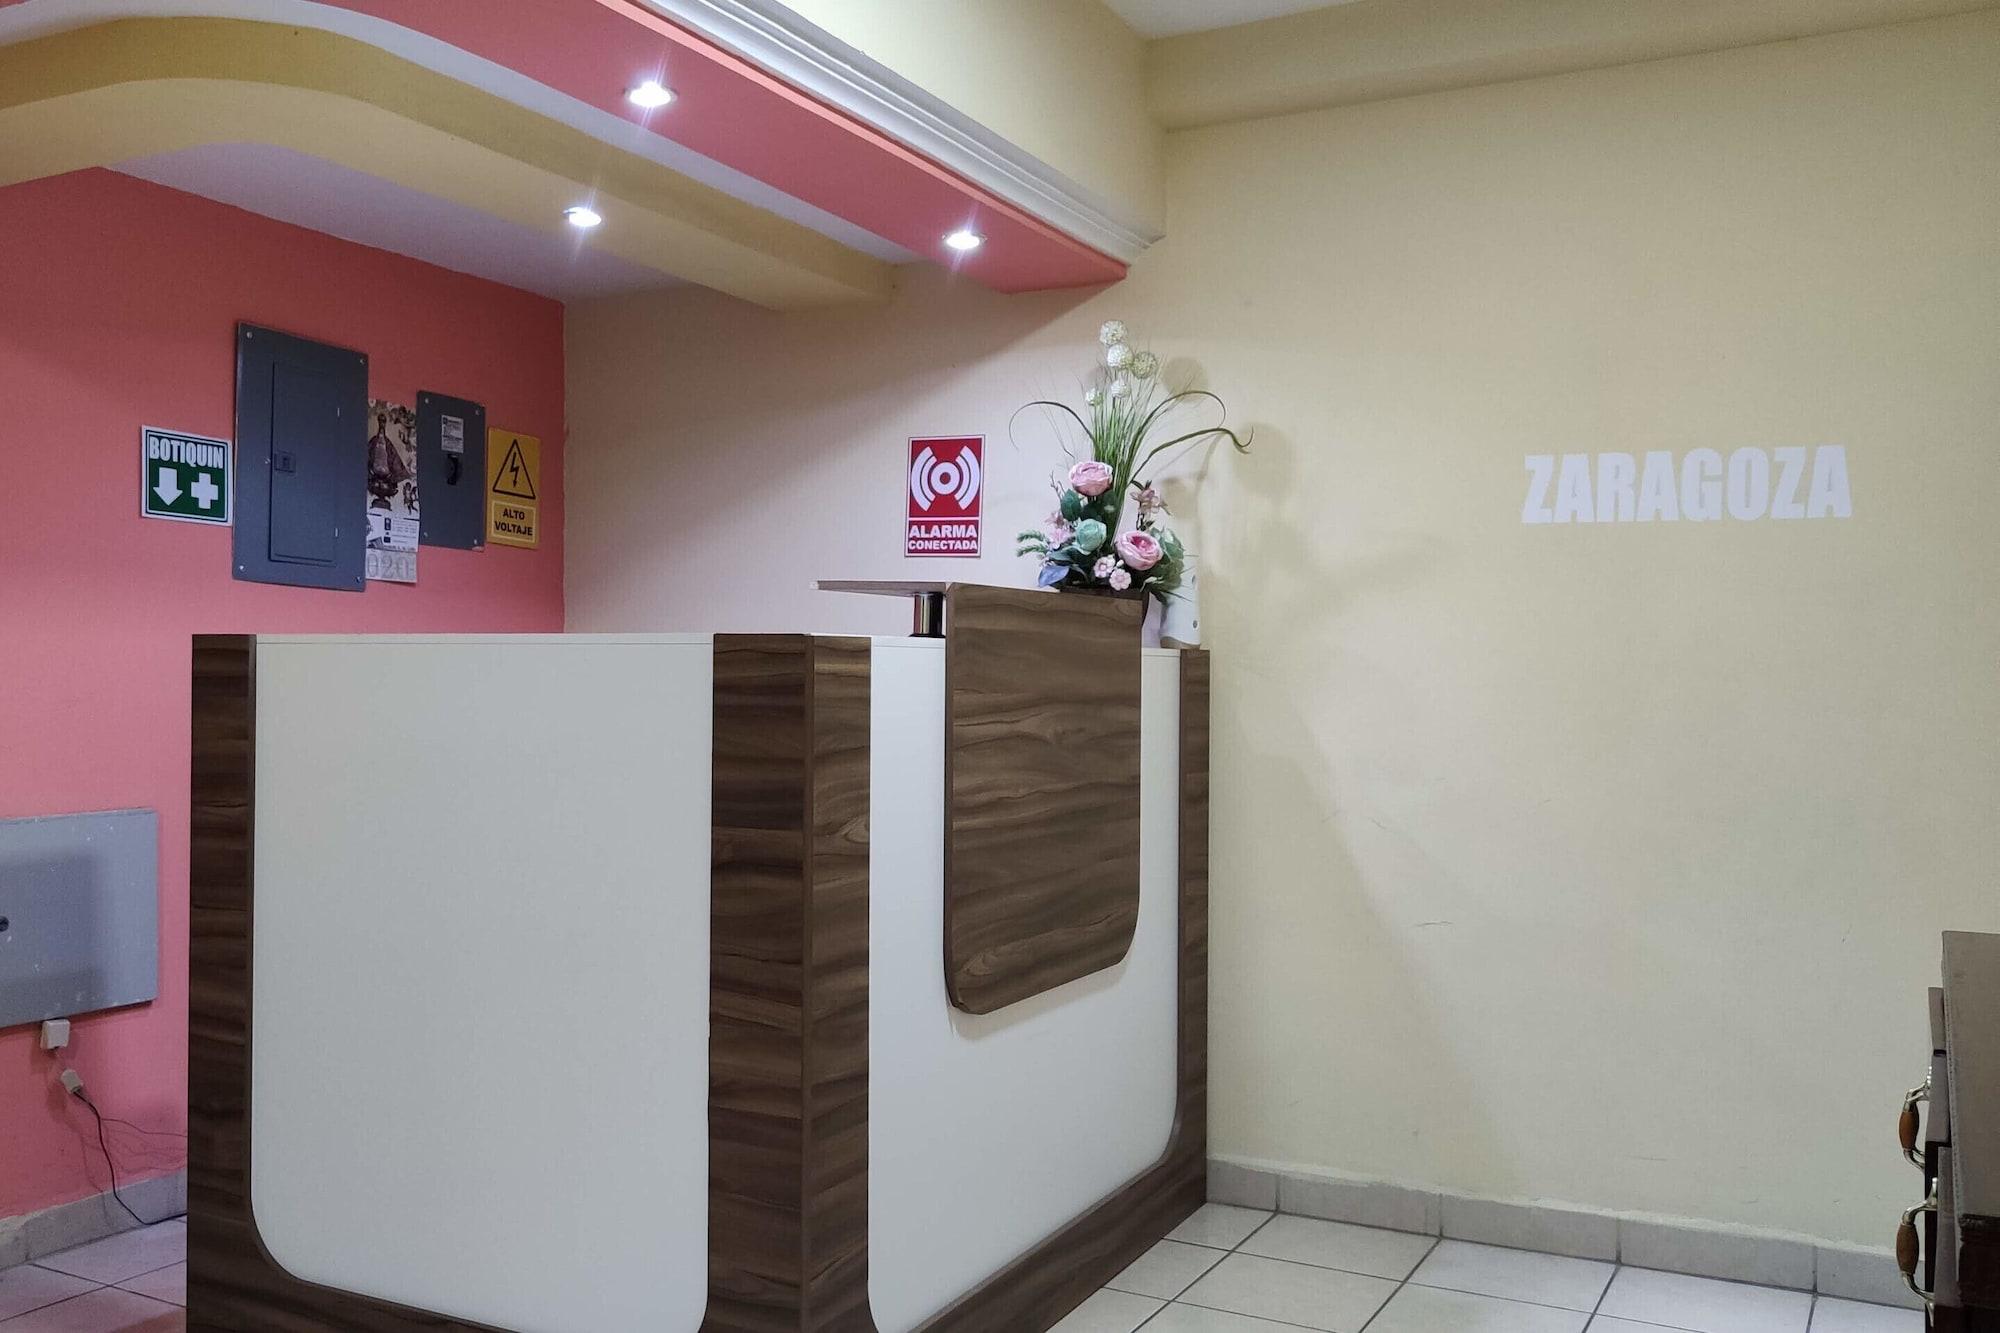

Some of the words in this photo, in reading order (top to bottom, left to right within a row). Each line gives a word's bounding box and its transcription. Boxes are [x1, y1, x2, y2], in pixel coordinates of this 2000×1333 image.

[149, 436, 224, 469] BOTIQUIN
[1521, 444, 1853, 524] ZARAGOZA
[502, 507, 525, 520] ALTO
[494, 520, 533, 536] VOLTAJE
[909, 524, 978, 538] ALARMA
[908, 540, 978, 550] CONECTADA
